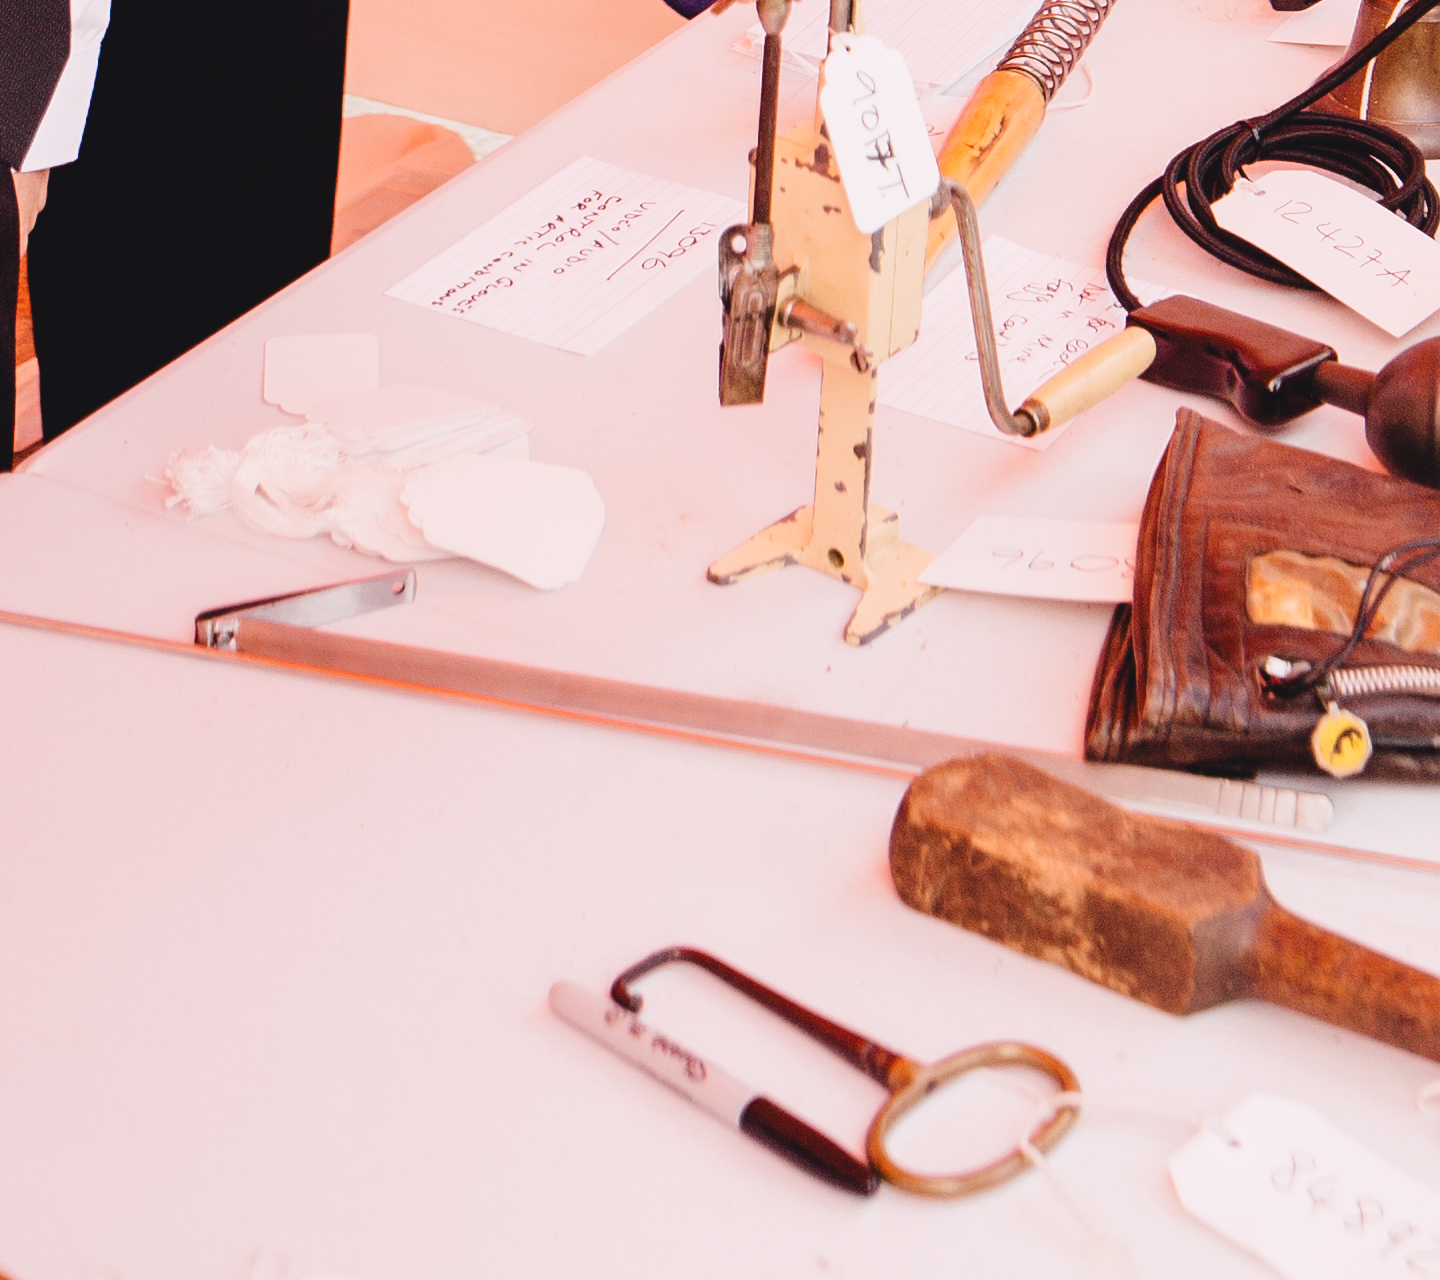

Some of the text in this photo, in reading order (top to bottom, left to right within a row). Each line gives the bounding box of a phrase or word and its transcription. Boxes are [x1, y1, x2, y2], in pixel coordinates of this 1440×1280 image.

[431, 189, 603, 307] FOR ARTIC CONDITIONS
[452, 195, 622, 314] CONTROL IN GLOVES
[641, 222, 717, 272] 13096
